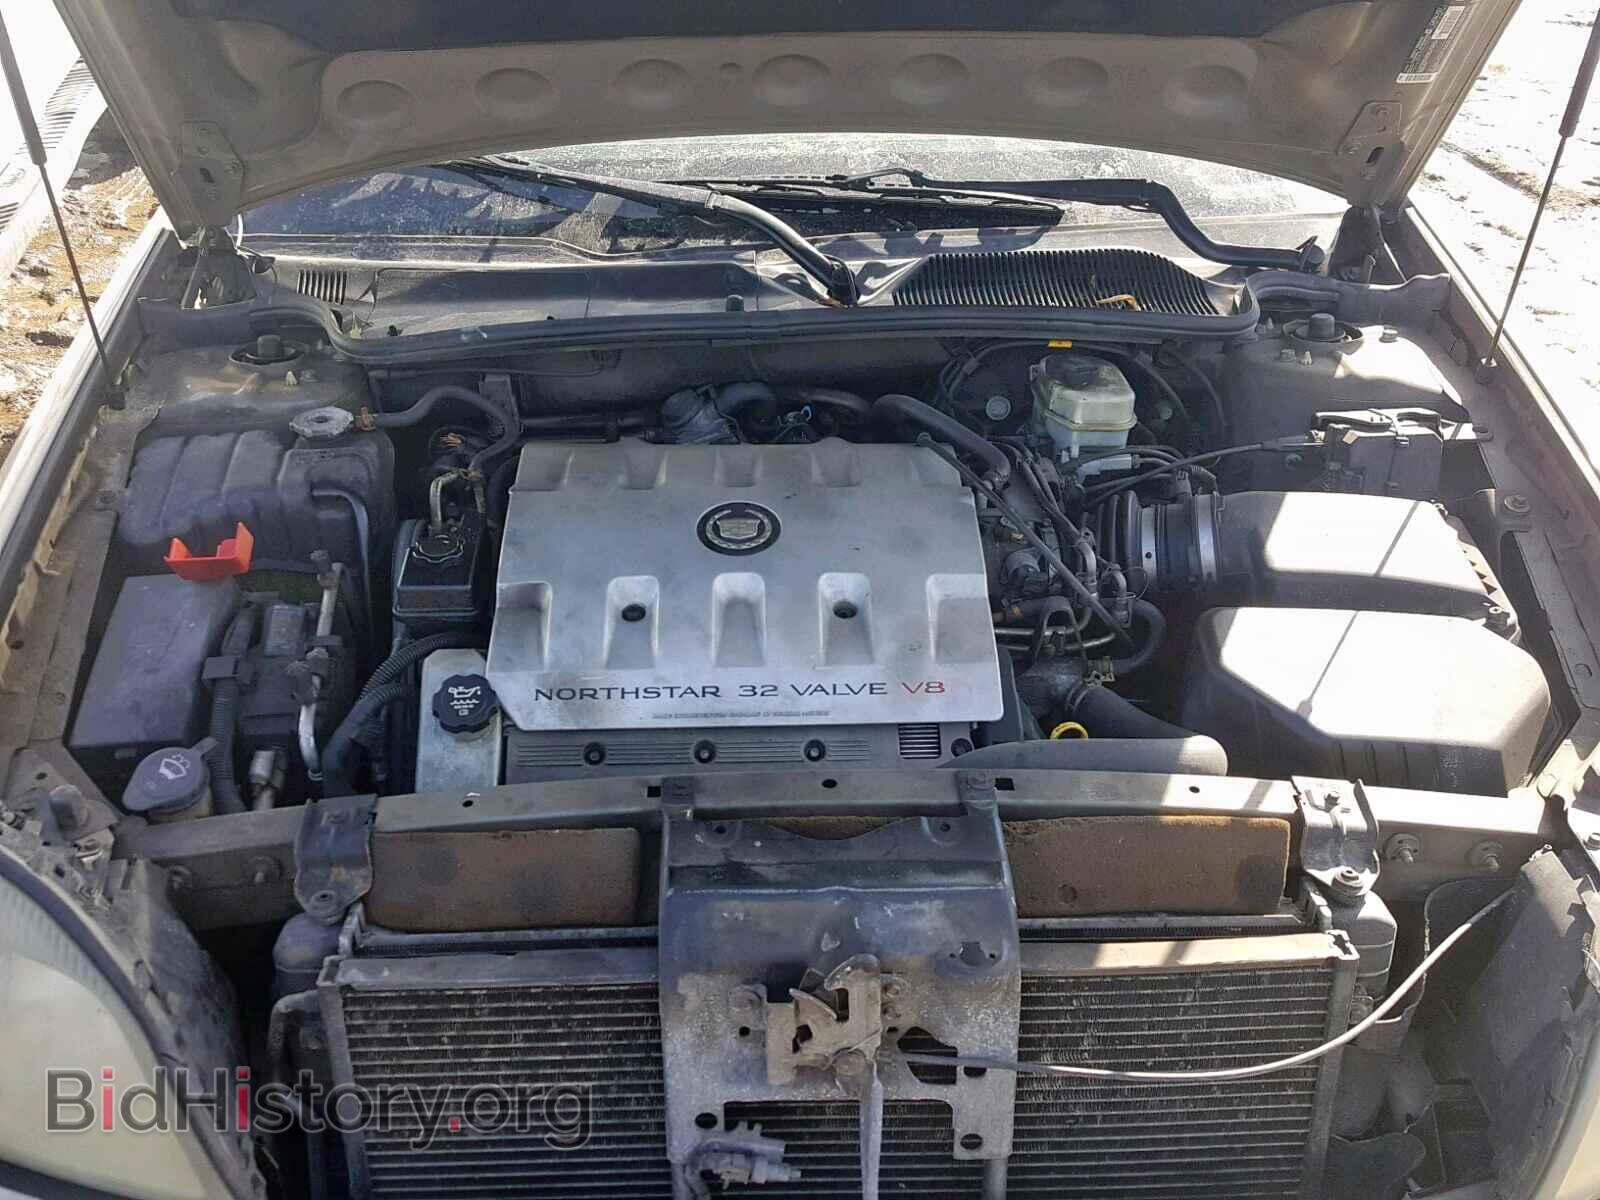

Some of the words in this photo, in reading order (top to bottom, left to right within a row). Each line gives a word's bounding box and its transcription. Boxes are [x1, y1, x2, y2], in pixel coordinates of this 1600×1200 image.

[535, 685, 721, 701] NORTHSTAR
[738, 684, 779, 697] 32
[790, 683, 888, 696] VALVE
[902, 681, 945, 694] V8
